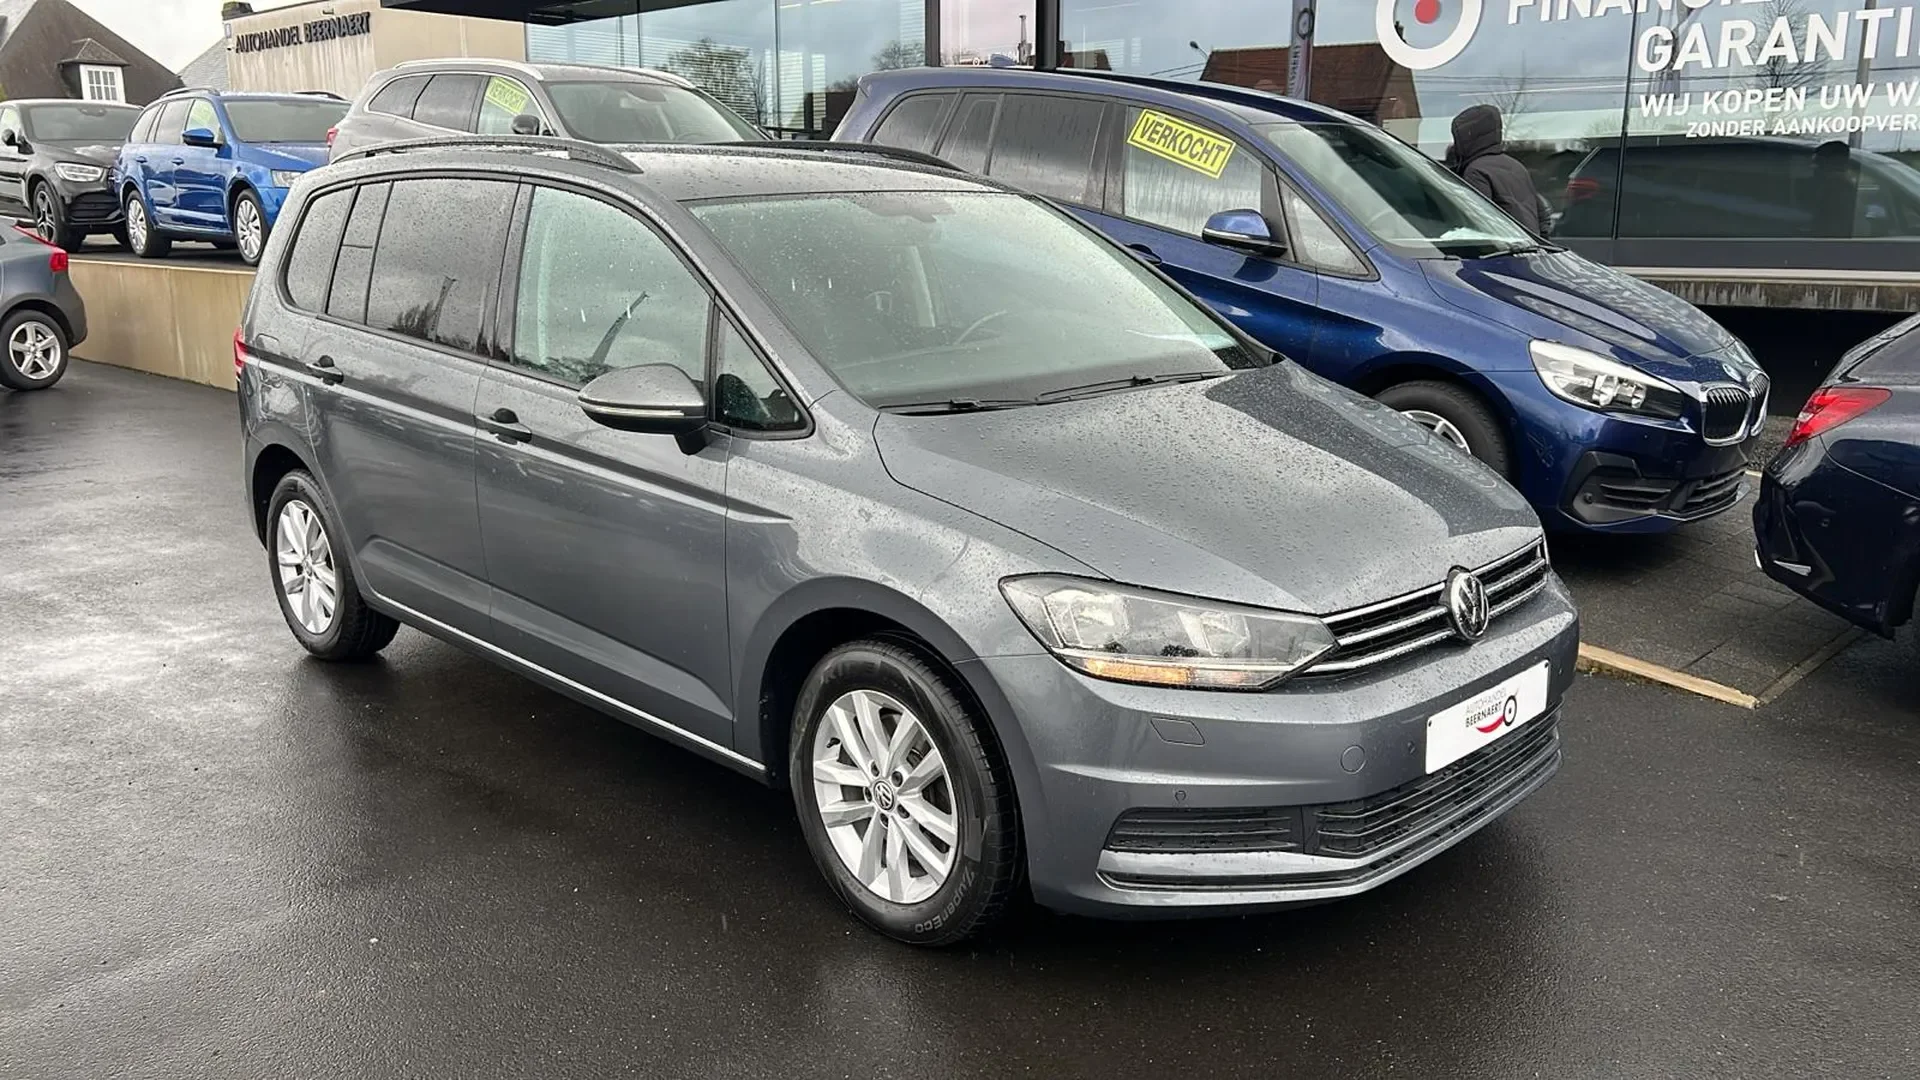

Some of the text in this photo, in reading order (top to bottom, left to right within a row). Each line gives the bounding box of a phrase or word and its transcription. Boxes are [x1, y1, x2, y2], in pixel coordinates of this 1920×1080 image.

[235, 12, 371, 53] AUTOHANDEL BEERNAERT
[1637, 6, 1920, 73] GARANTI
[1640, 77, 1920, 118] WIJ KOPEN UW W
[1139, 117, 1226, 167] VERKOCHT
[1685, 113, 1920, 138] ZONDER AANKOOPVER
[1465, 702, 1502, 728] BEERNAERT
